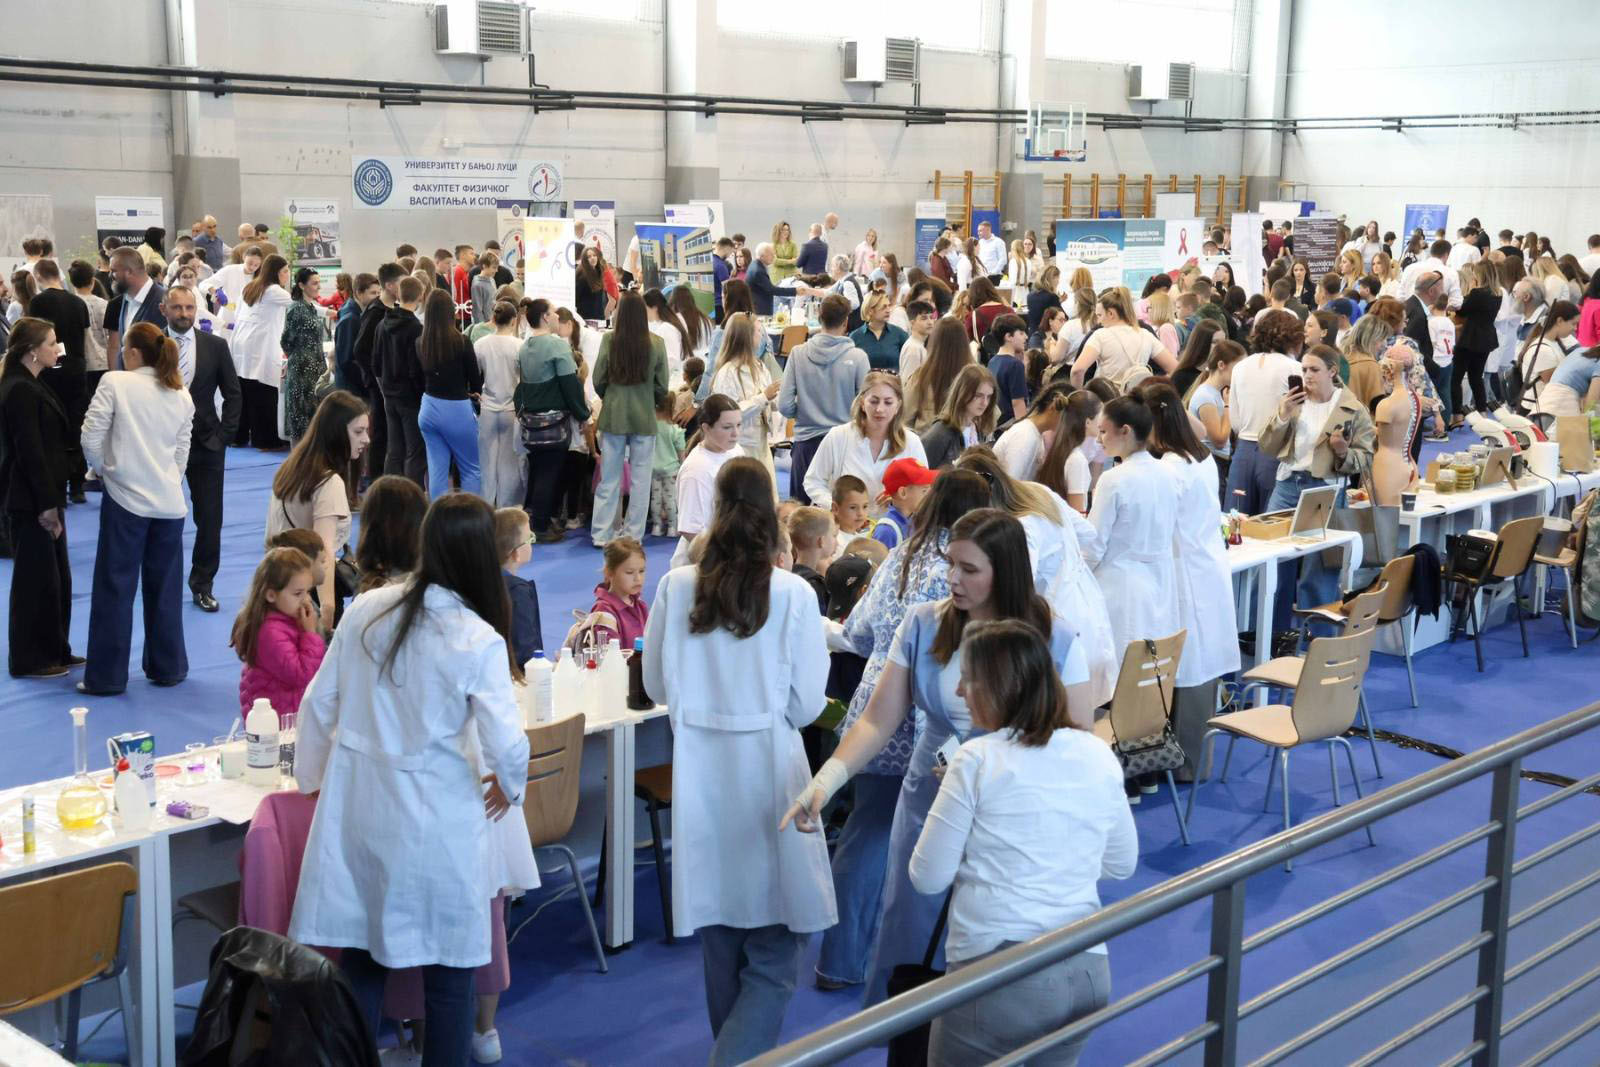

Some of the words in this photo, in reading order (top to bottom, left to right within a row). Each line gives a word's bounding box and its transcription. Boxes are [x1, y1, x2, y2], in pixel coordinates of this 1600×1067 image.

[404, 161, 460, 170] УНИВЕРЗИТЕТ
[462, 162, 467, 170] У
[468, 162, 495, 171] БАЊОЈ
[496, 163, 518, 172] ЛУЦИ
[412, 184, 460, 193] ФАКУЛТЕТ
[462, 184, 510, 193] ФИЗИЧКОГ
[409, 196, 468, 206] ВАСПИТАЊА
[469, 197, 476, 206] И
[477, 197, 507, 206] СПО
